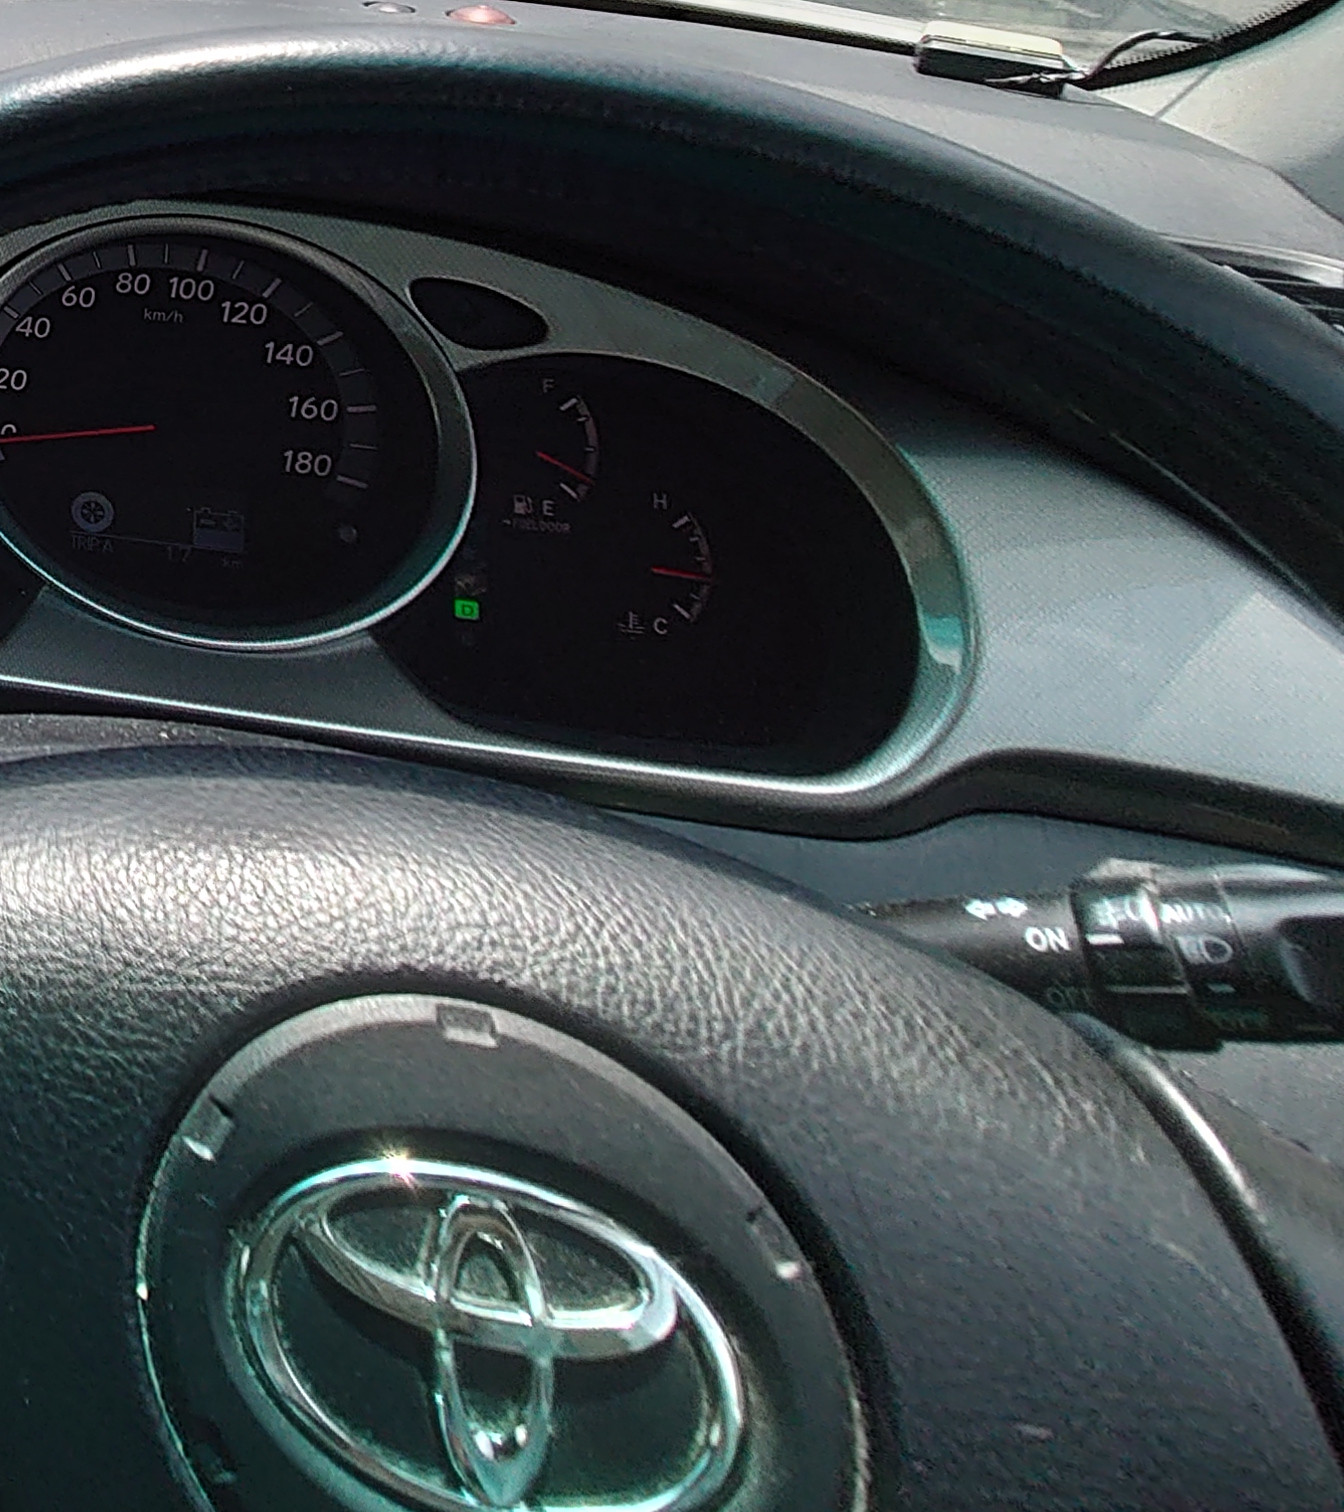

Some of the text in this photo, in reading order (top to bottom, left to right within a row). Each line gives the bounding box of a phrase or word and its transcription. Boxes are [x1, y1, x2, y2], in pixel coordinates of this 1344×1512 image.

[115, 273, 151, 296] 80
[168, 277, 215, 302] 100
[61, 286, 96, 309] 60
[143, 308, 184, 324] km/h
[221, 301, 268, 326] 120
[15, 316, 51, 339] 40
[264, 341, 314, 367] 140
[542, 379, 554, 394] F
[288, 397, 338, 422] 160
[283, 449, 332, 477] 180
[542, 499, 555, 516] E
[653, 492, 669, 510] H
[653, 617, 668, 635] C
[1023, 926, 1071, 953] ON
